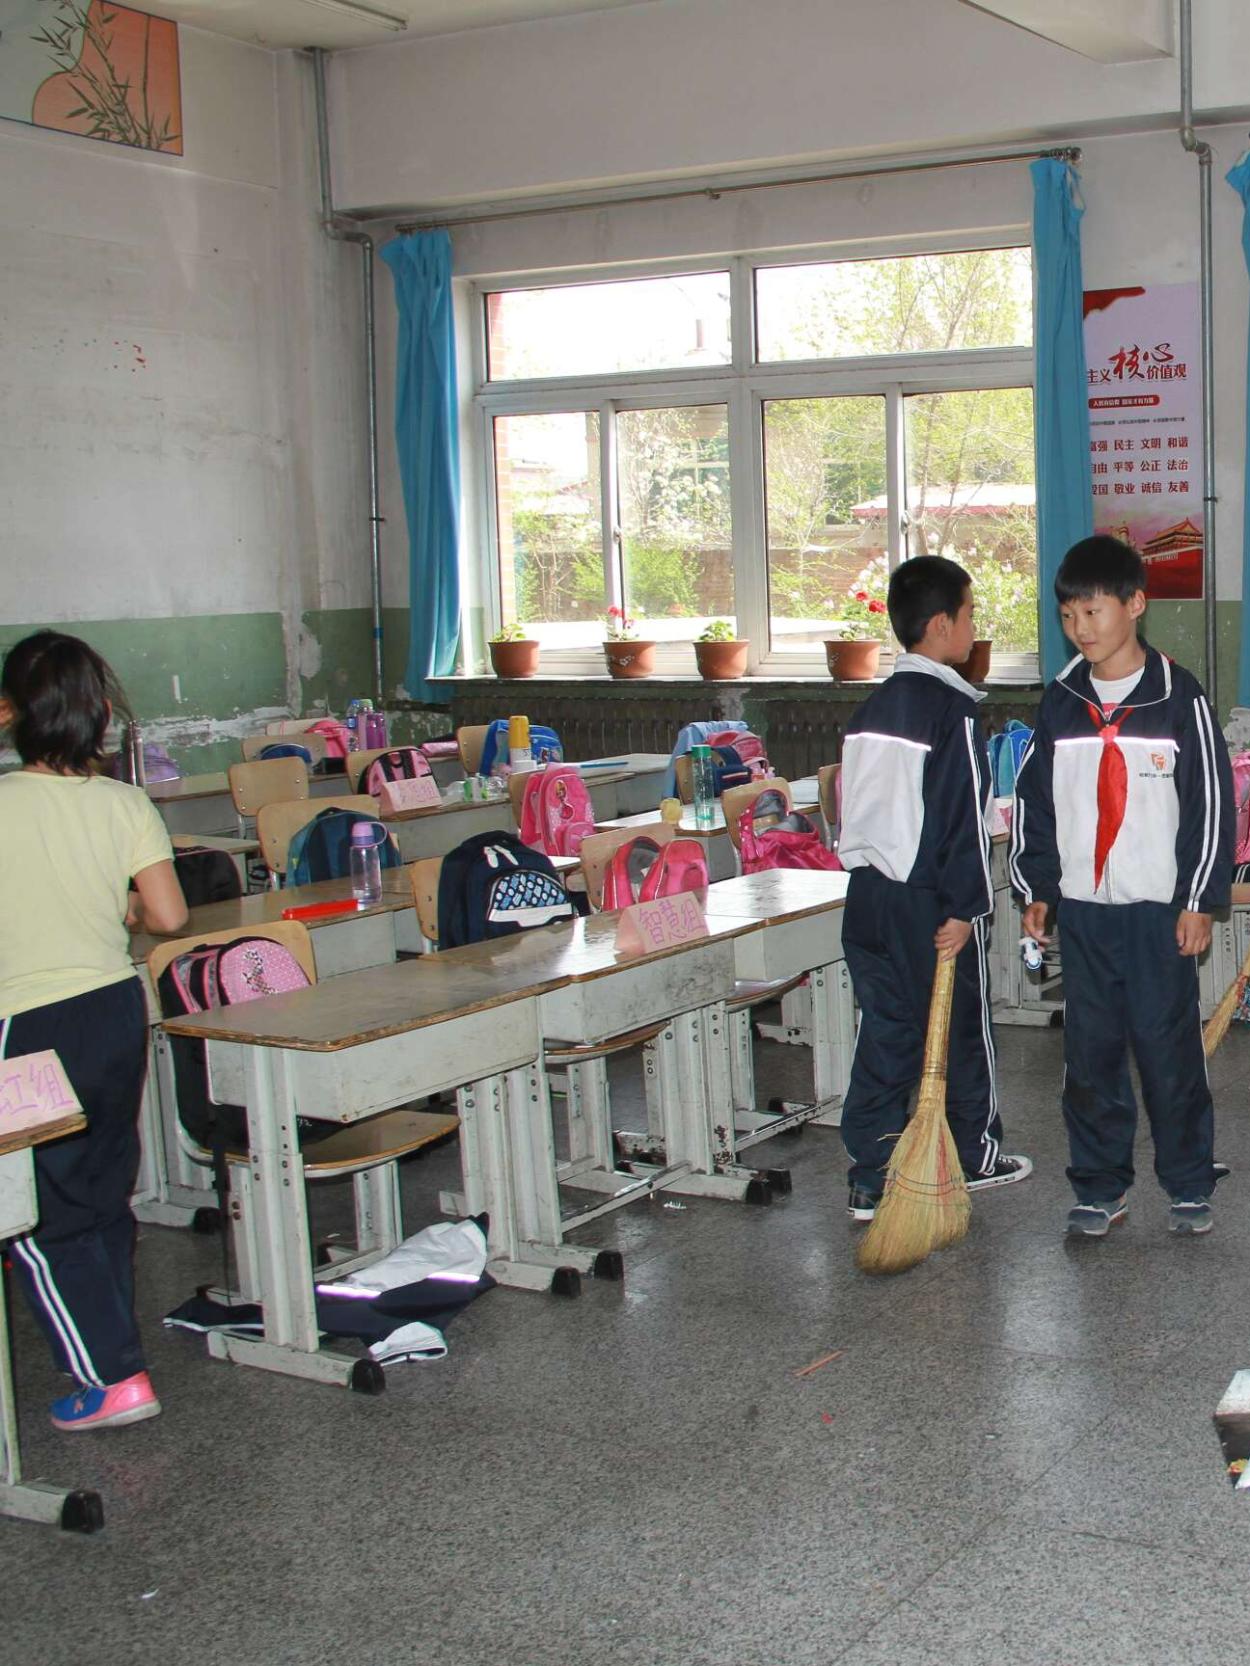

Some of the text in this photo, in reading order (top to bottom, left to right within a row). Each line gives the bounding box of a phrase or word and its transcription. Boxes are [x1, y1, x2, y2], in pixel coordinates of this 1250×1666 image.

[1114, 439, 1134, 450] 民主
[1141, 438, 1161, 449] 文明
[1168, 436, 1188, 448] 和谐
[1113, 461, 1134, 472] 平等
[1140, 460, 1161, 471] 公正
[1167, 458, 1188, 470] 法治
[1114, 483, 1135, 494] 敬业
[1141, 482, 1162, 494] 诚信
[1168, 481, 1189, 493] 友善
[639, 899, 706, 944] 智慧组
